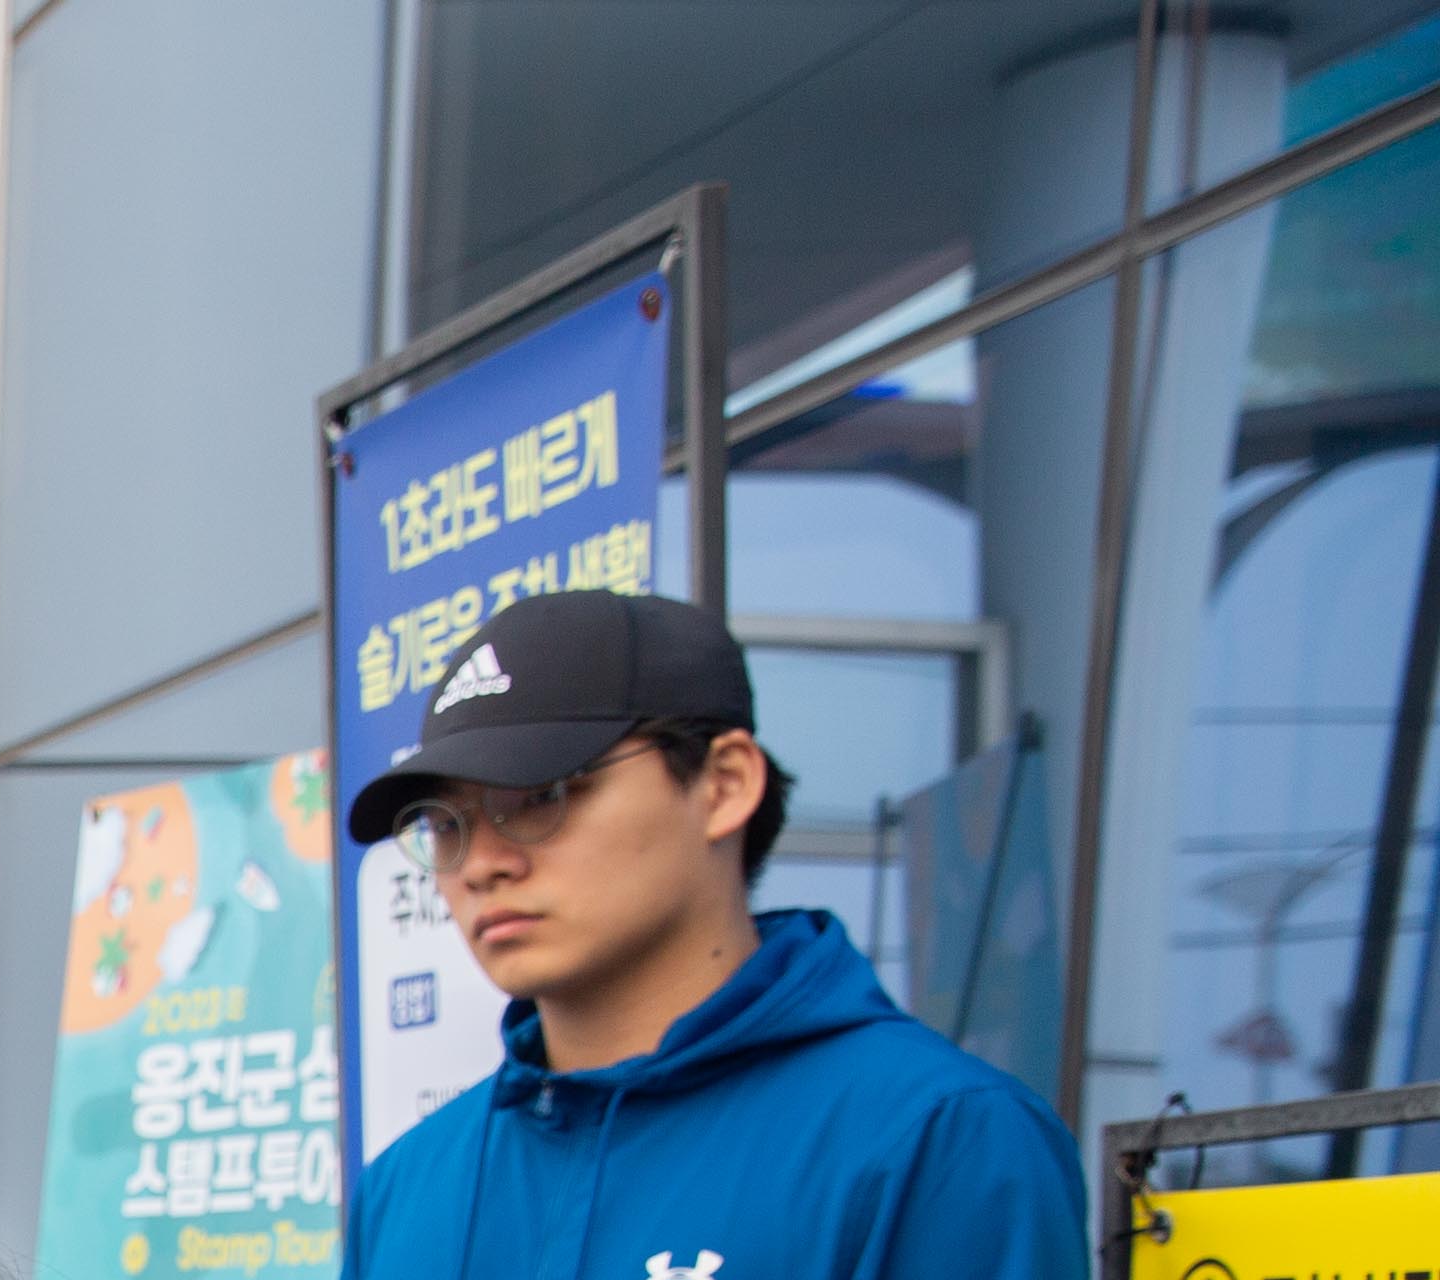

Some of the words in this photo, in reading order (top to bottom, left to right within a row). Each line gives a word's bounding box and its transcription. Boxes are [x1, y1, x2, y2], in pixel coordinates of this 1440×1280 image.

[380, 446, 501, 573] 1초라도
[502, 389, 618, 525] 빠르게
[133, 1030, 295, 1138] 옹진군
[177, 1225, 270, 1277] Stamp
